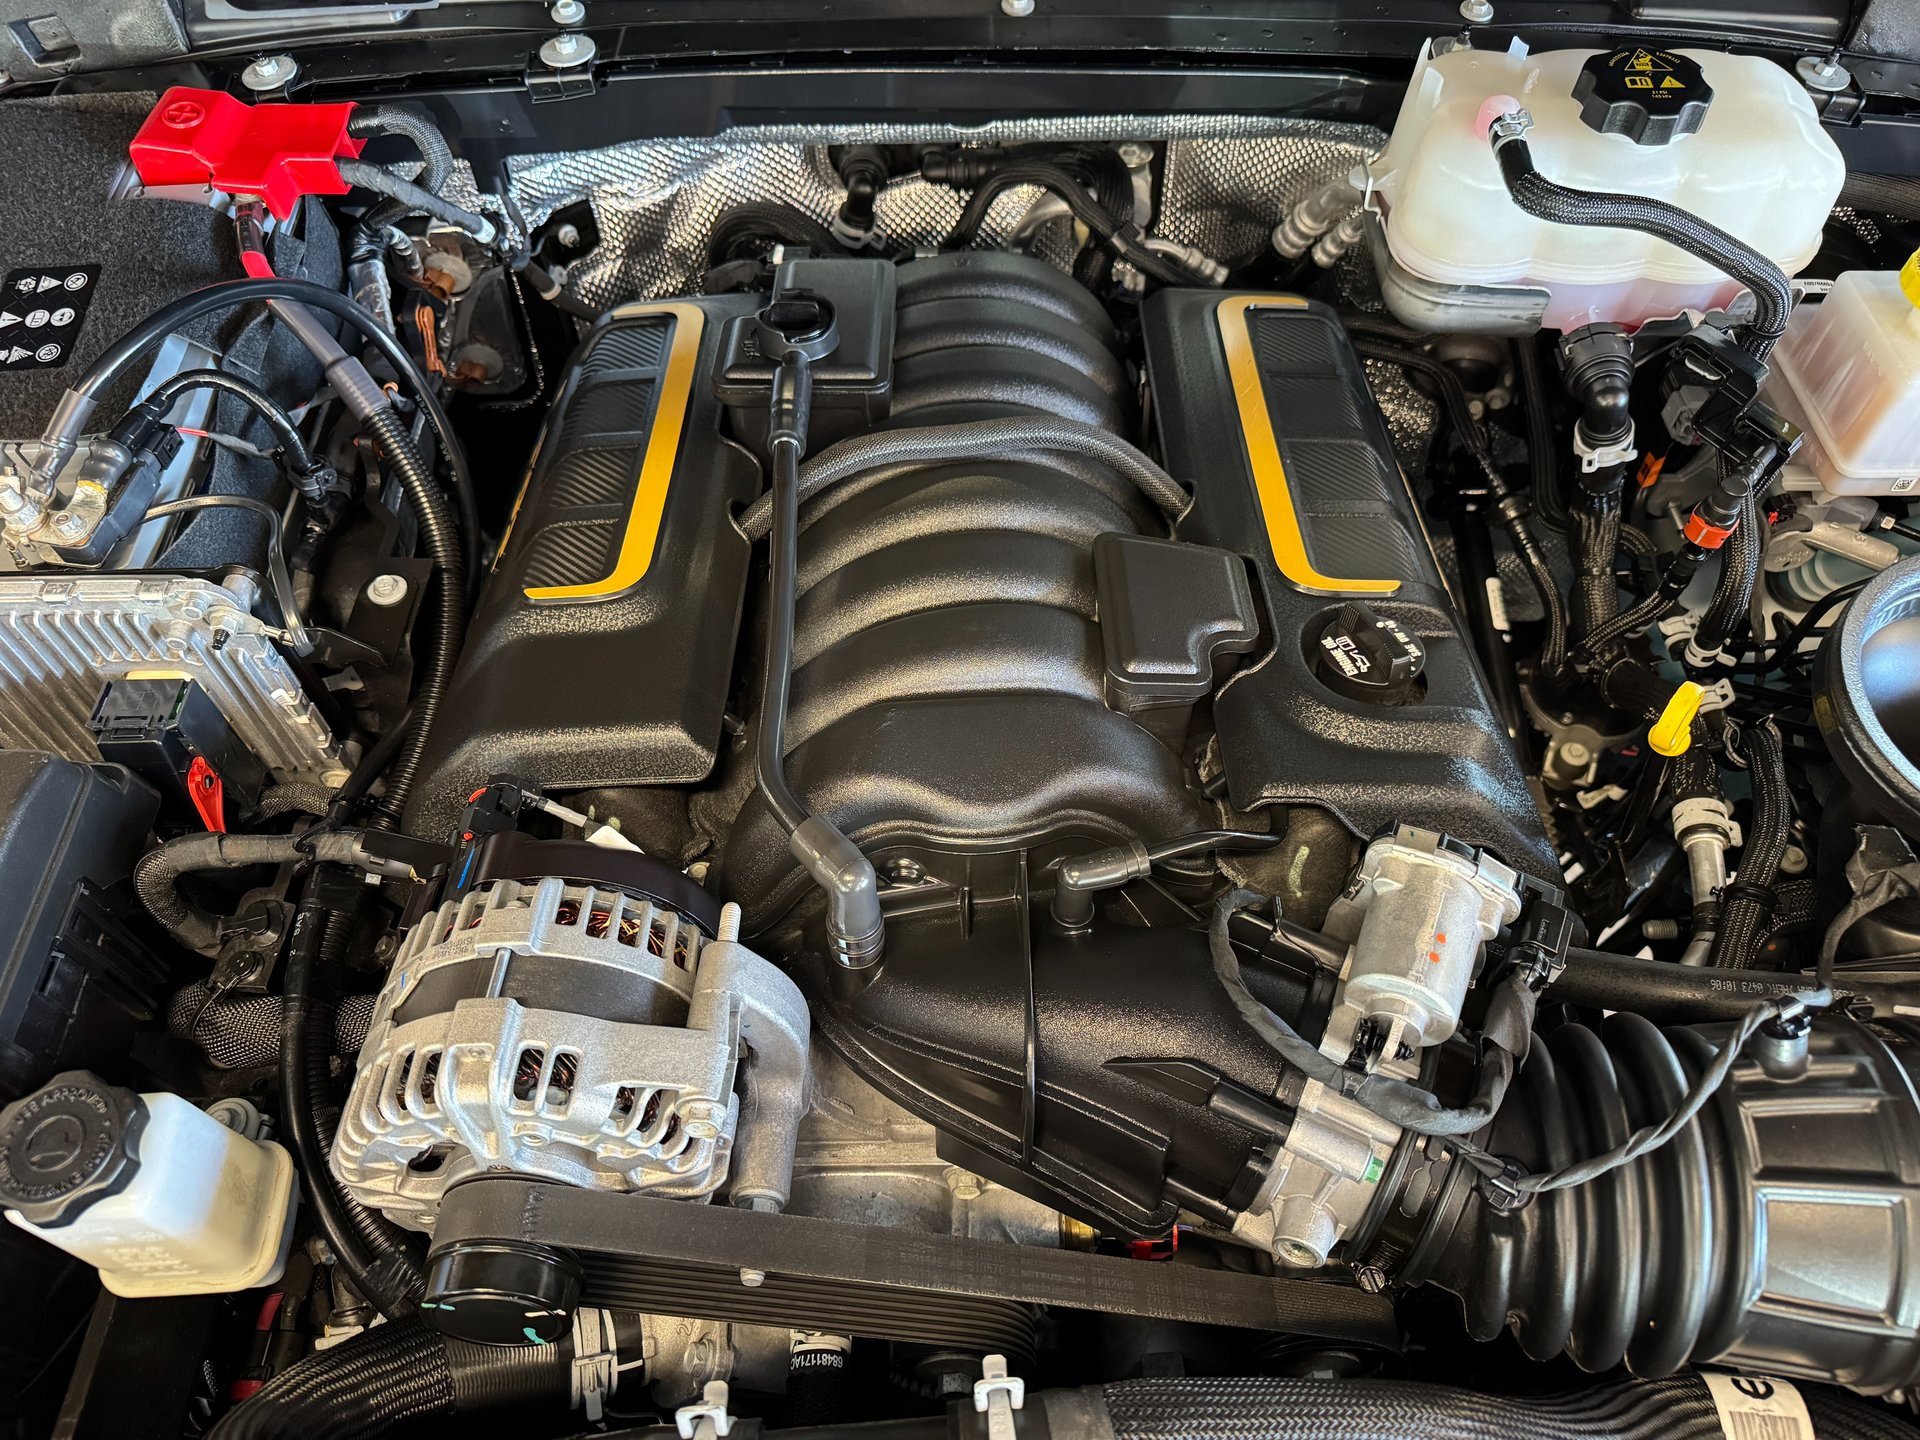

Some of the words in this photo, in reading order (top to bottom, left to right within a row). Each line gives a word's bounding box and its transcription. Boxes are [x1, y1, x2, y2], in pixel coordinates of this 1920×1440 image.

[414, 393, 439, 434] COPPER
[1320, 635, 1338, 652] OIL
[1404, 642, 1422, 658] SAE
[1330, 647, 1360, 677] ENGINE
[1710, 978, 1737, 991] 10:06
[1741, 980, 1764, 993] 0473
[42, 1088, 108, 1113] APPROVED
[791, 1353, 843, 1370] 68481171AC
